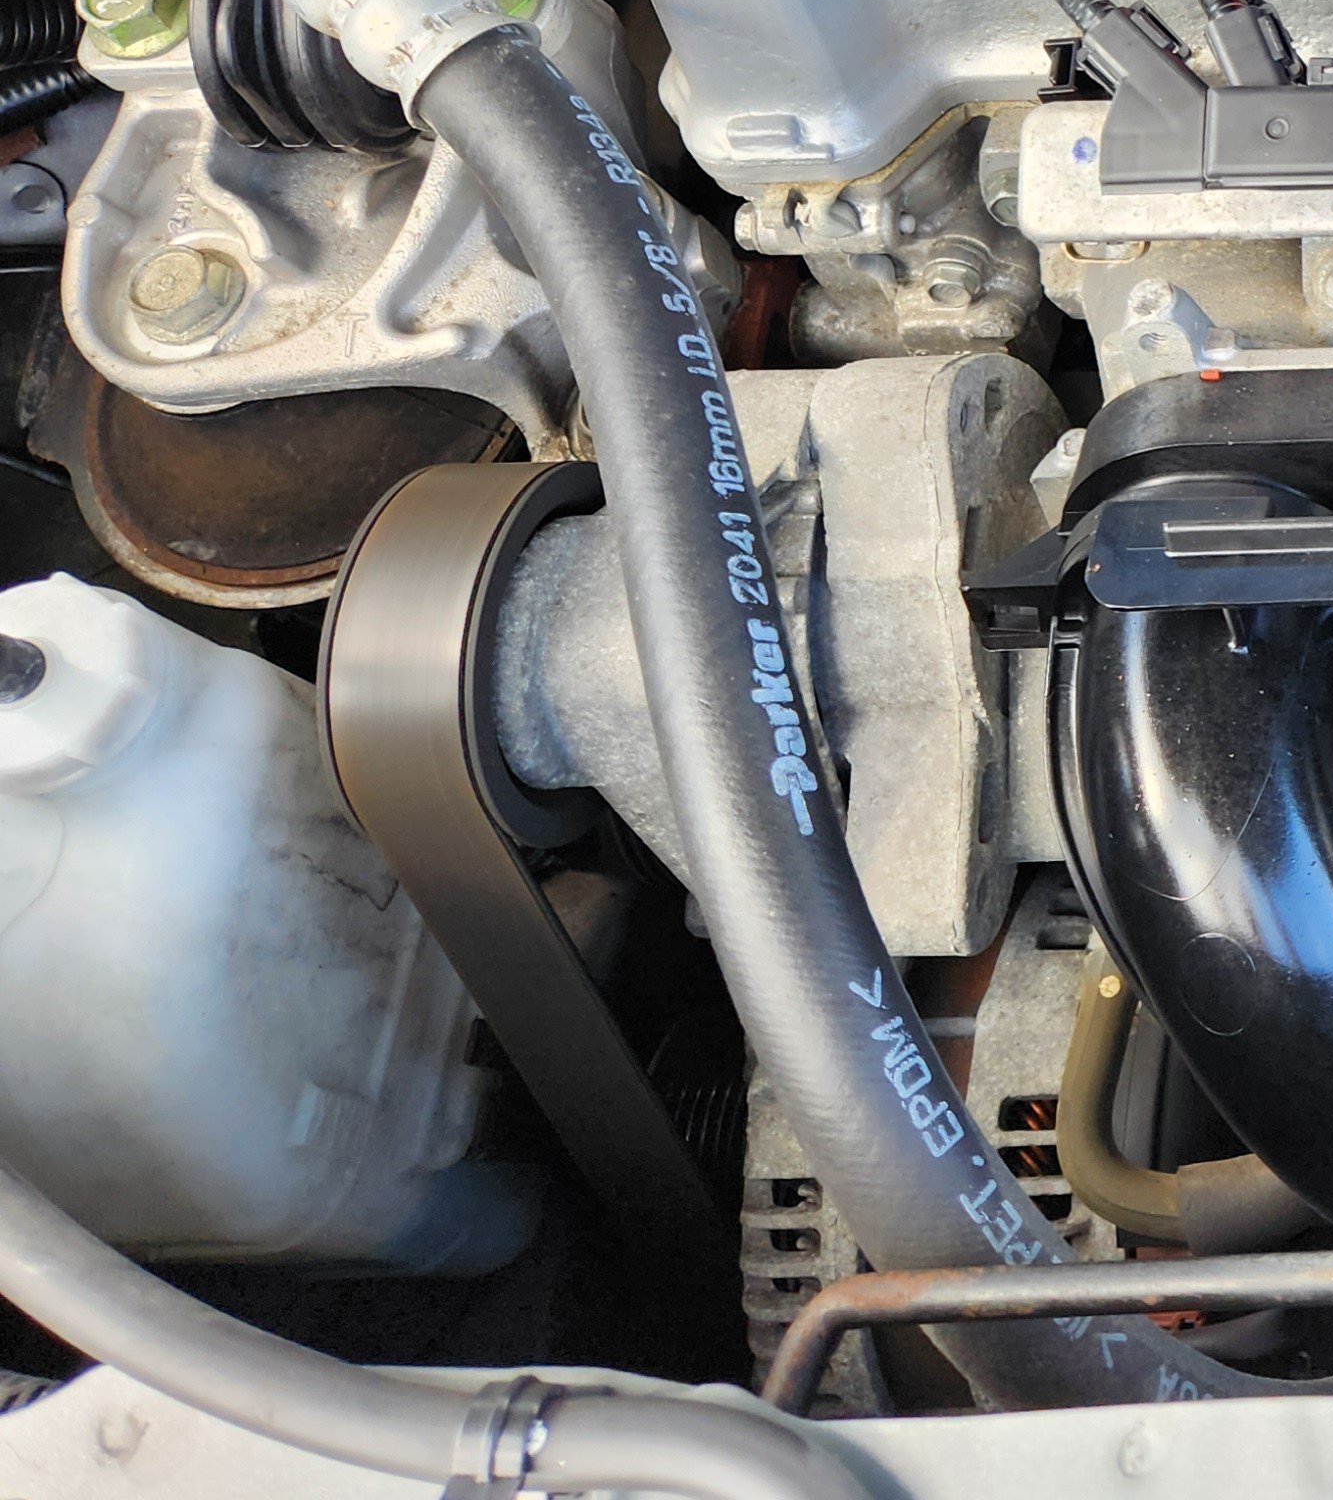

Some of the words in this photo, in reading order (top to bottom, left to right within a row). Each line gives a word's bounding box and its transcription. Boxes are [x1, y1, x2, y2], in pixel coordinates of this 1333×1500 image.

[569, 93, 641, 187] R134a
[700, 390, 746, 499] 16mm
[747, 617, 818, 836] Parker
